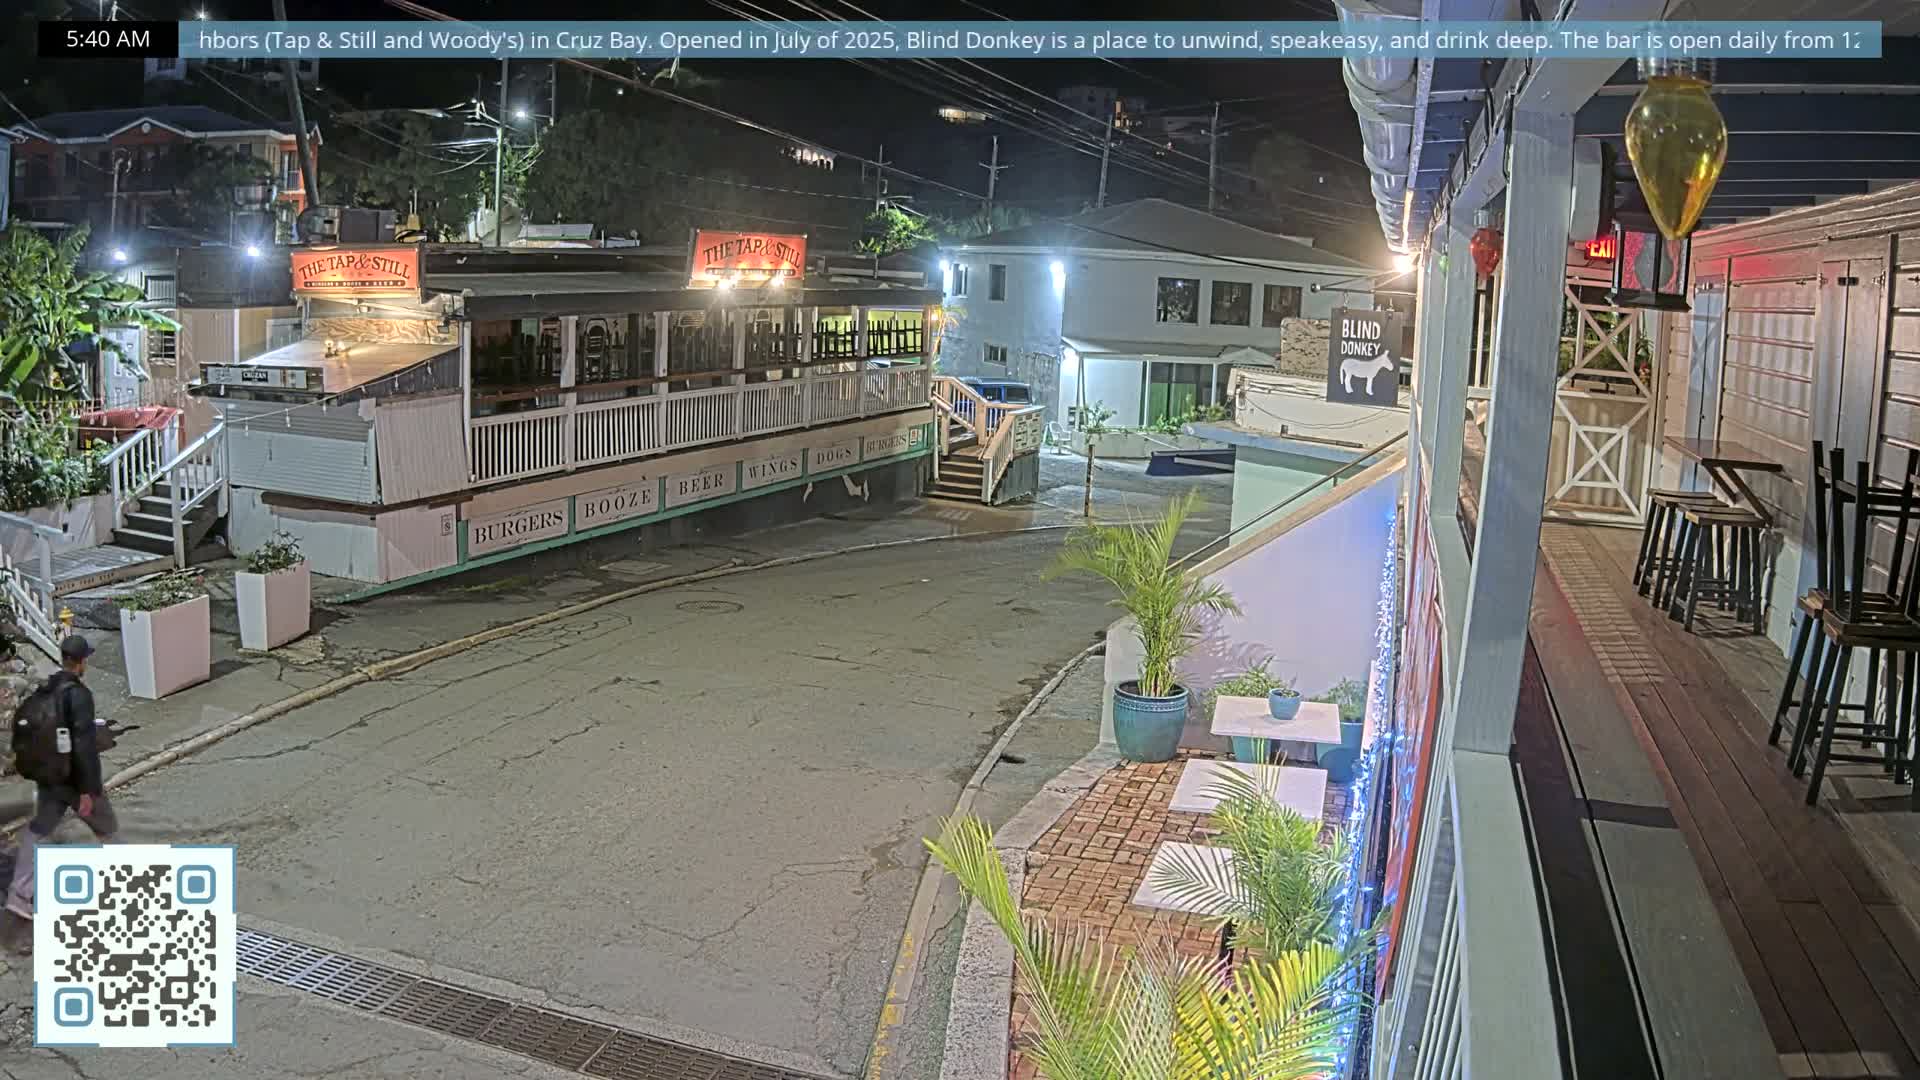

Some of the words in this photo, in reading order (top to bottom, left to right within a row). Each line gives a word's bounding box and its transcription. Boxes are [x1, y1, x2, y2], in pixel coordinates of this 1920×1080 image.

[703, 241, 734, 266] THE
[735, 238, 762, 255] TAP
[760, 238, 775, 257] &
[774, 241, 801, 268] STILL
[298, 259, 326, 280] THE
[326, 255, 355, 271] TAP
[354, 253, 372, 270] &
[371, 256, 411, 280] STILL
[1342, 319, 1381, 340] BLIND
[1340, 340, 1381, 357] DONKEY
[865, 433, 908, 453] BURGERS
[748, 458, 799, 480] WINGS
[816, 449, 853, 466] DOGS
[679, 472, 725, 496] BEER
[584, 489, 652, 519] BOOZE
[474, 510, 564, 545] BURGERS
